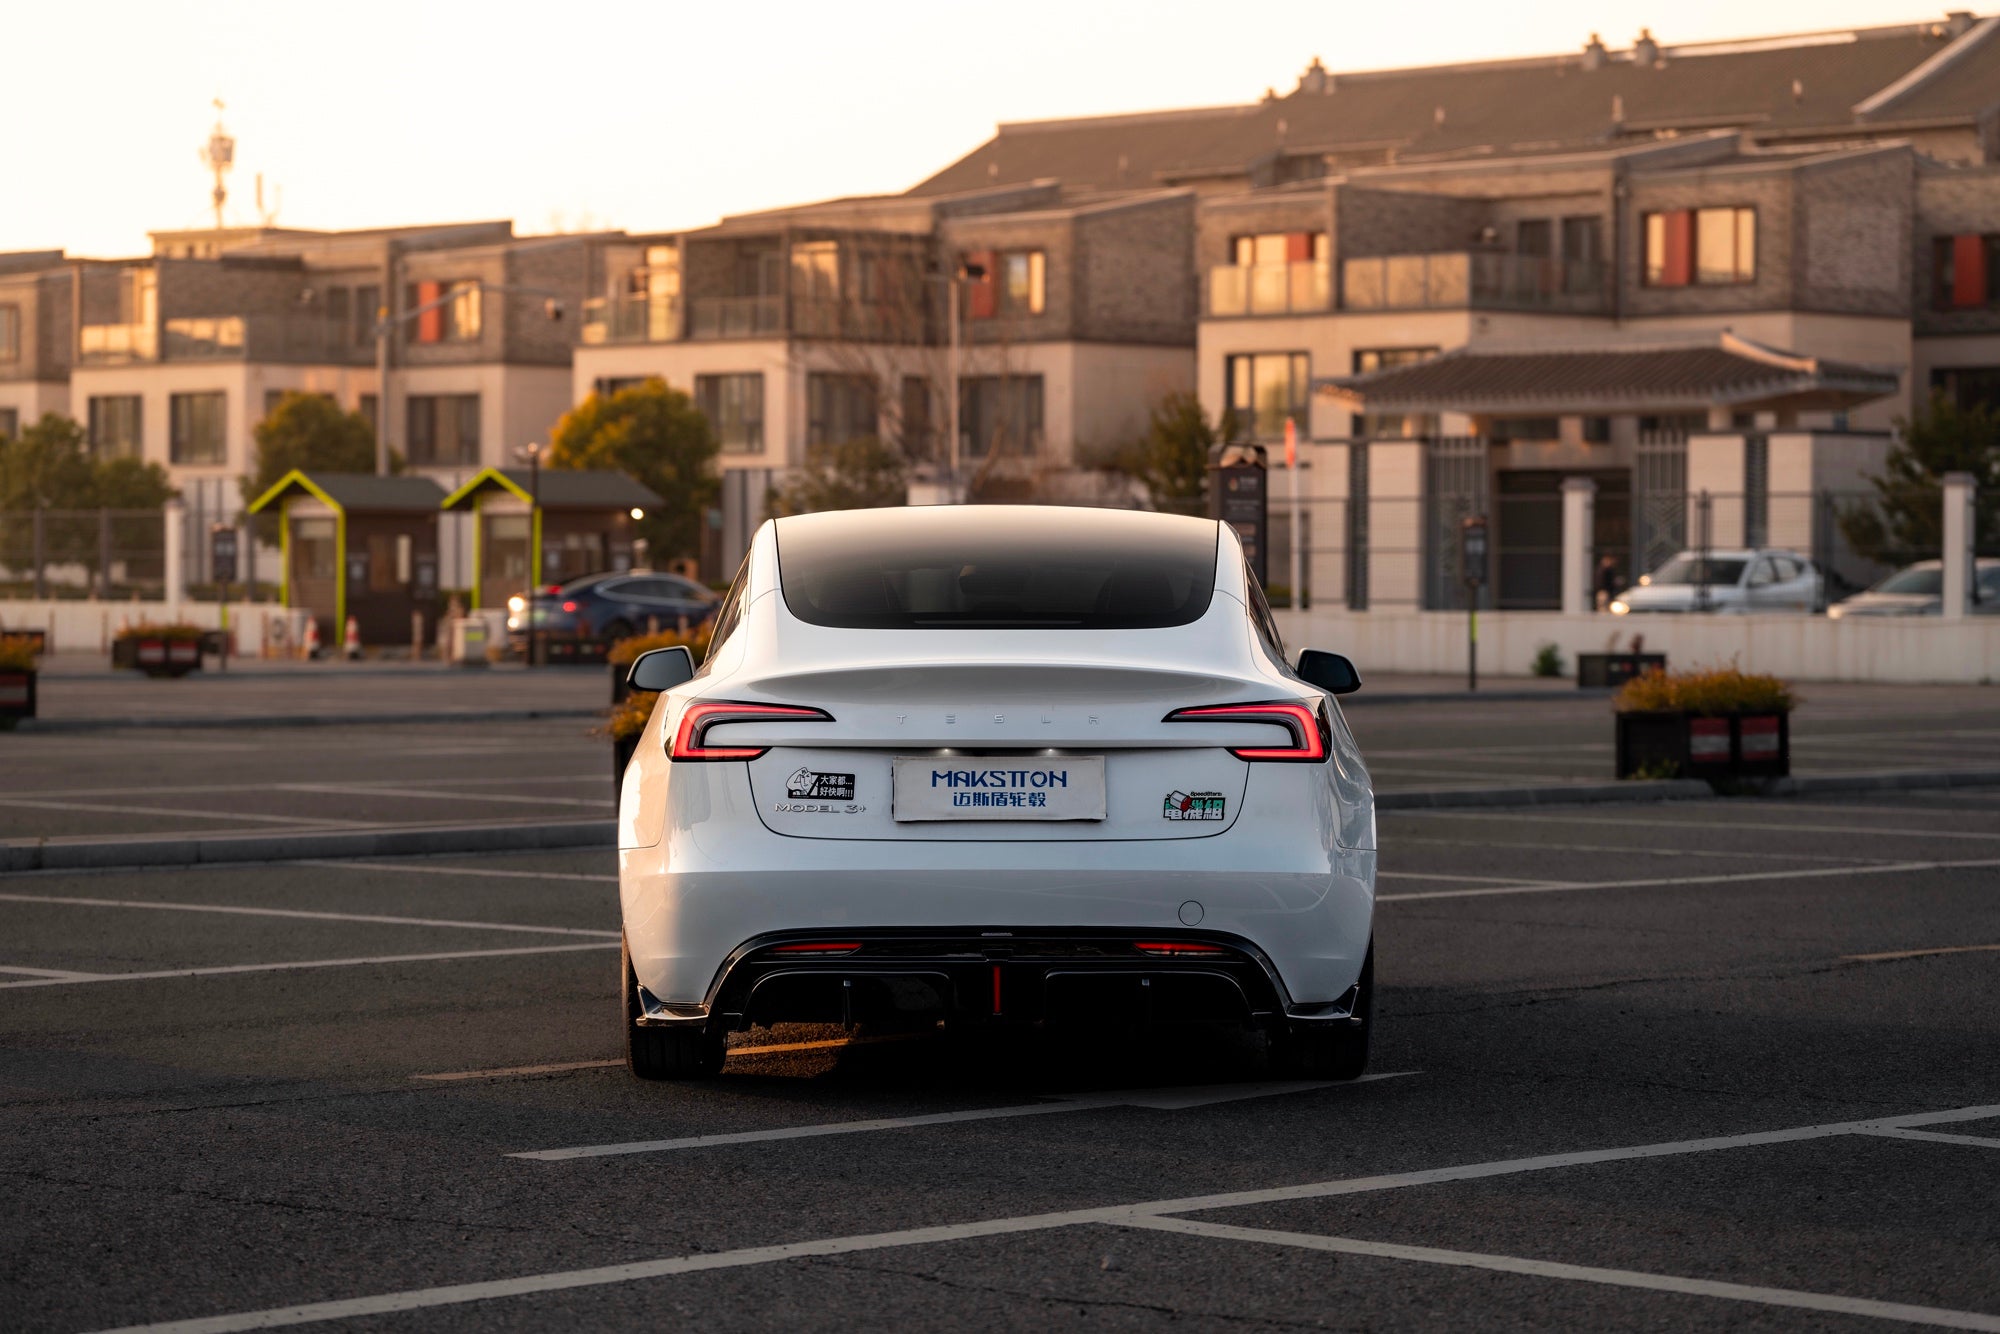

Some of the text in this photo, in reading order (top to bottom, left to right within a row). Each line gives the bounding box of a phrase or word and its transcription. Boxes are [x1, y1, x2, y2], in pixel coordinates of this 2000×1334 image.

[897, 714, 1098, 724] TESLA
[953, 791, 1047, 808] 迈斯盾轮毂
[775, 803, 840, 813] MODEL
